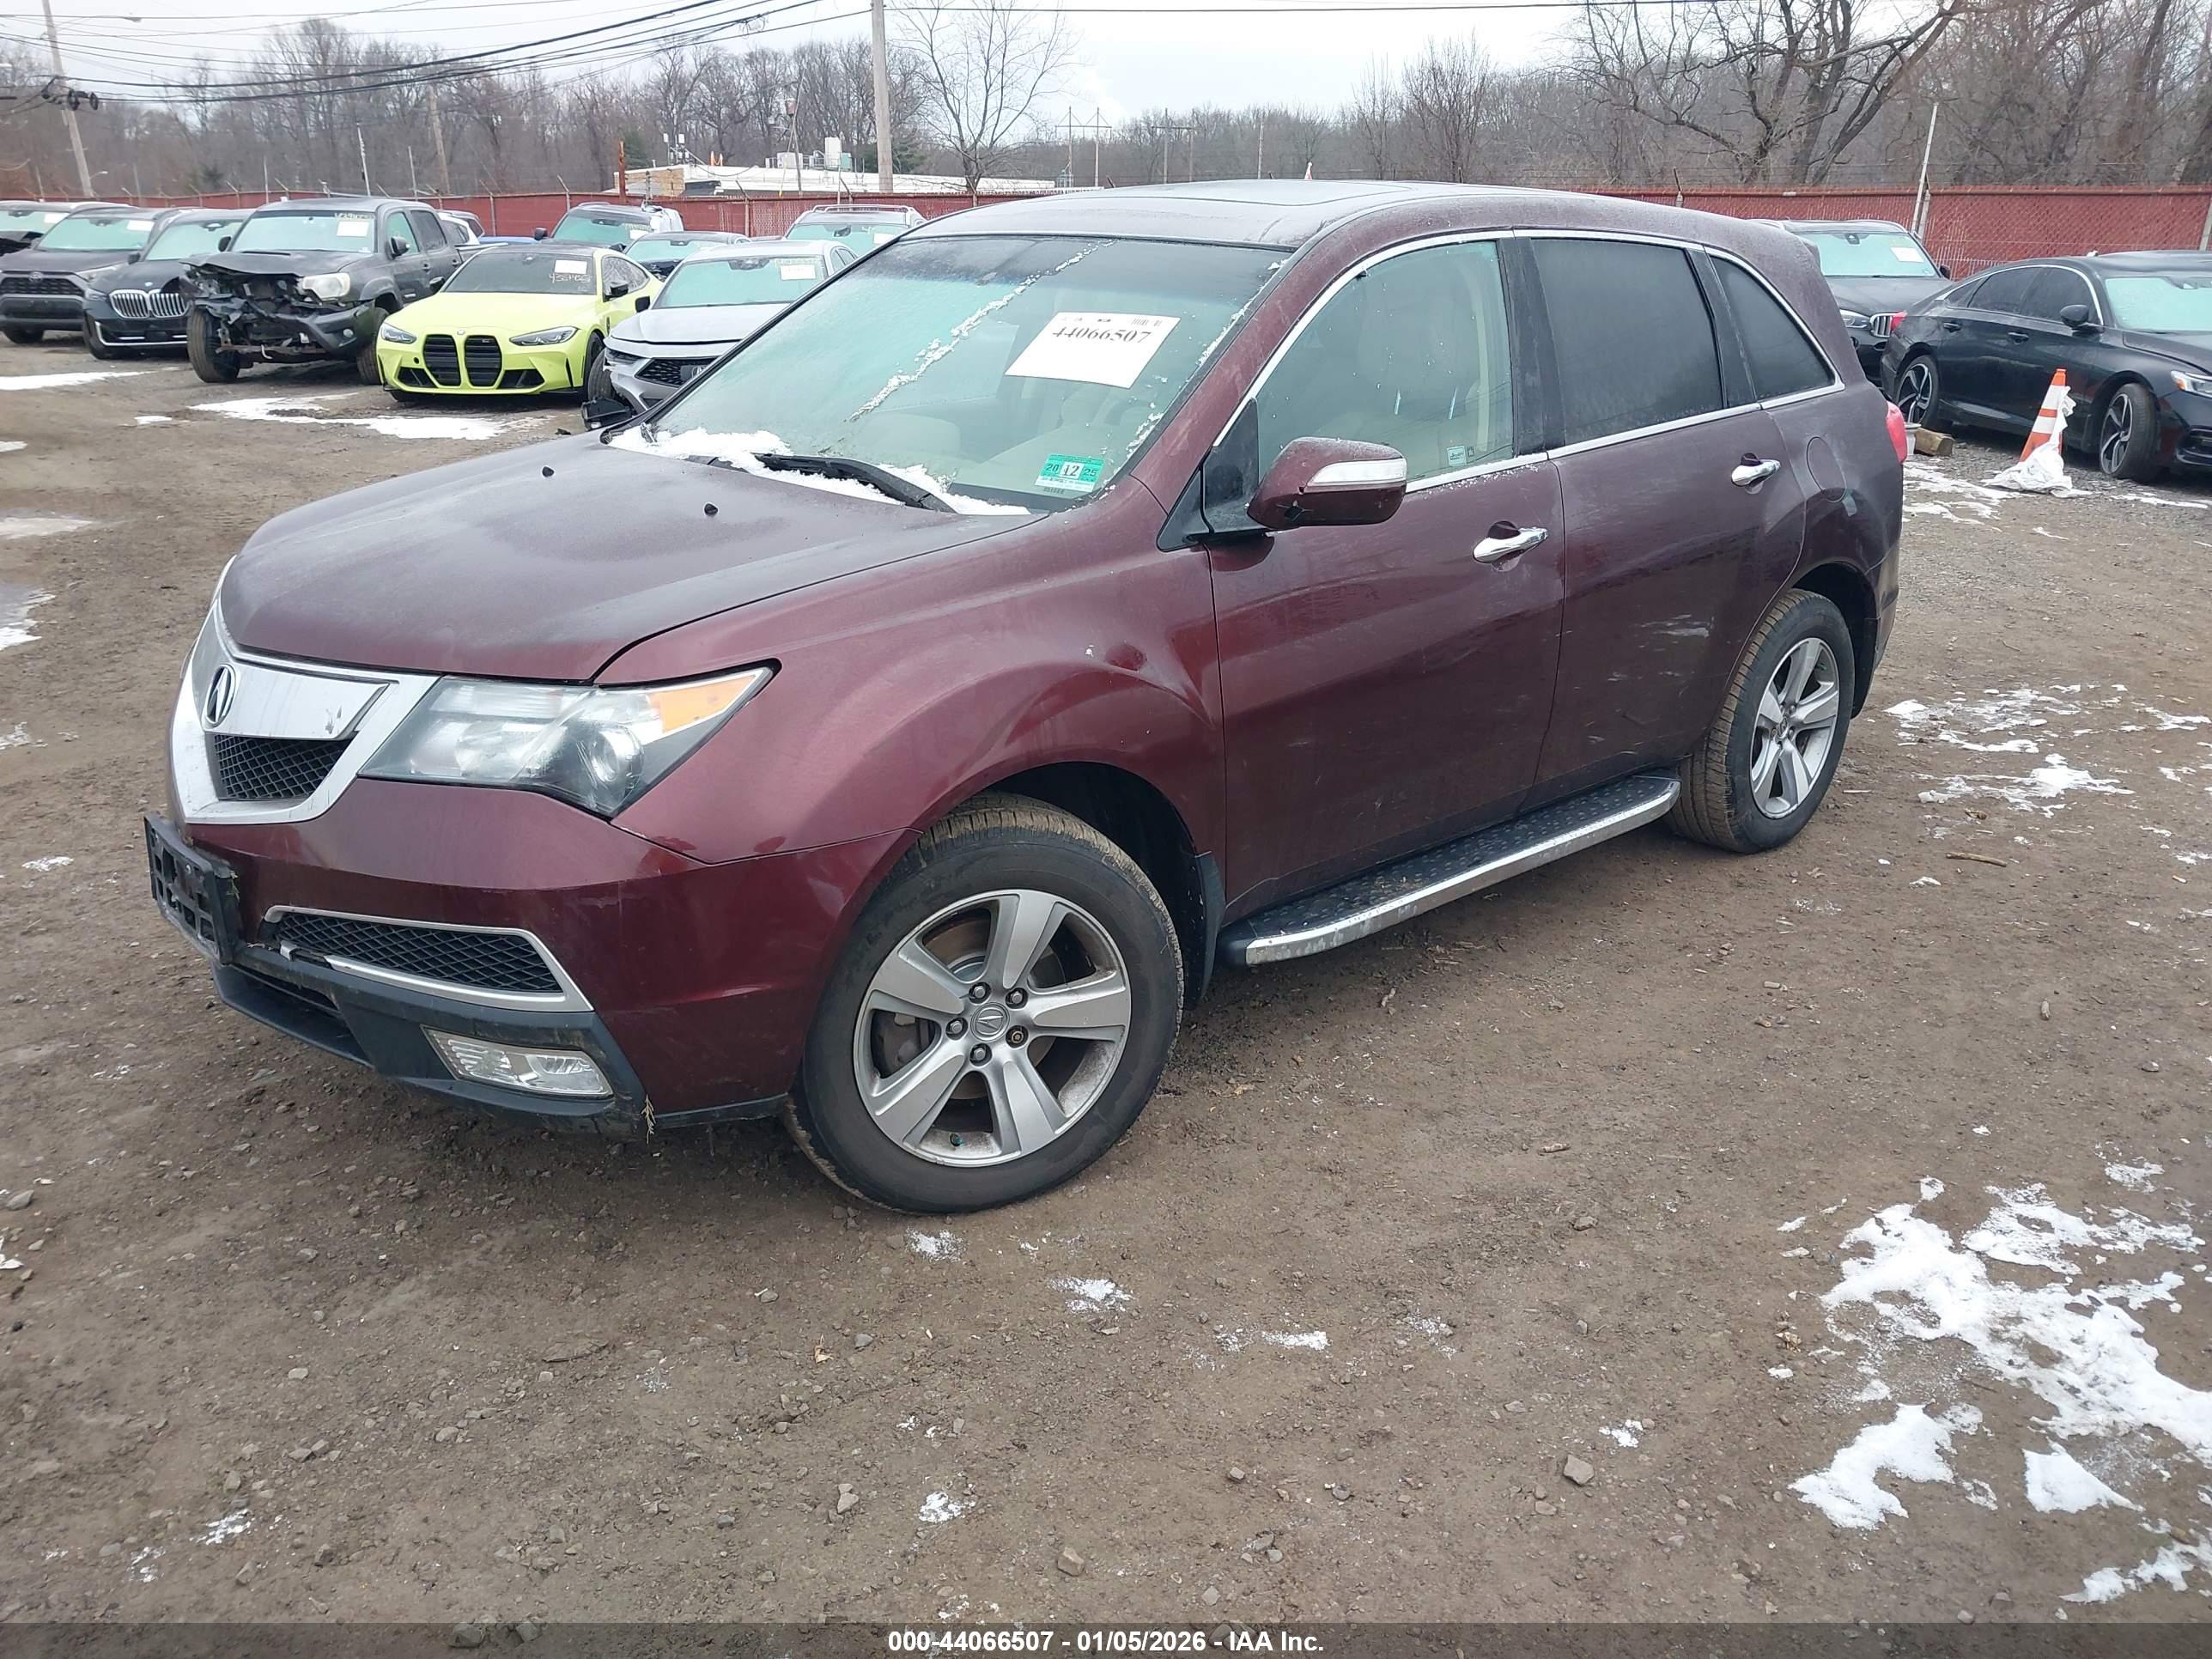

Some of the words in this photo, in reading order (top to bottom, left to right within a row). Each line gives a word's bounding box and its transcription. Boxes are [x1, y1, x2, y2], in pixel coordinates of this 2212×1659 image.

[1053, 326, 1152, 343] 44066507
[1045, 463, 1060, 472] 20
[1063, 465, 1080, 477] 12
[1083, 468, 1097, 477] 25
